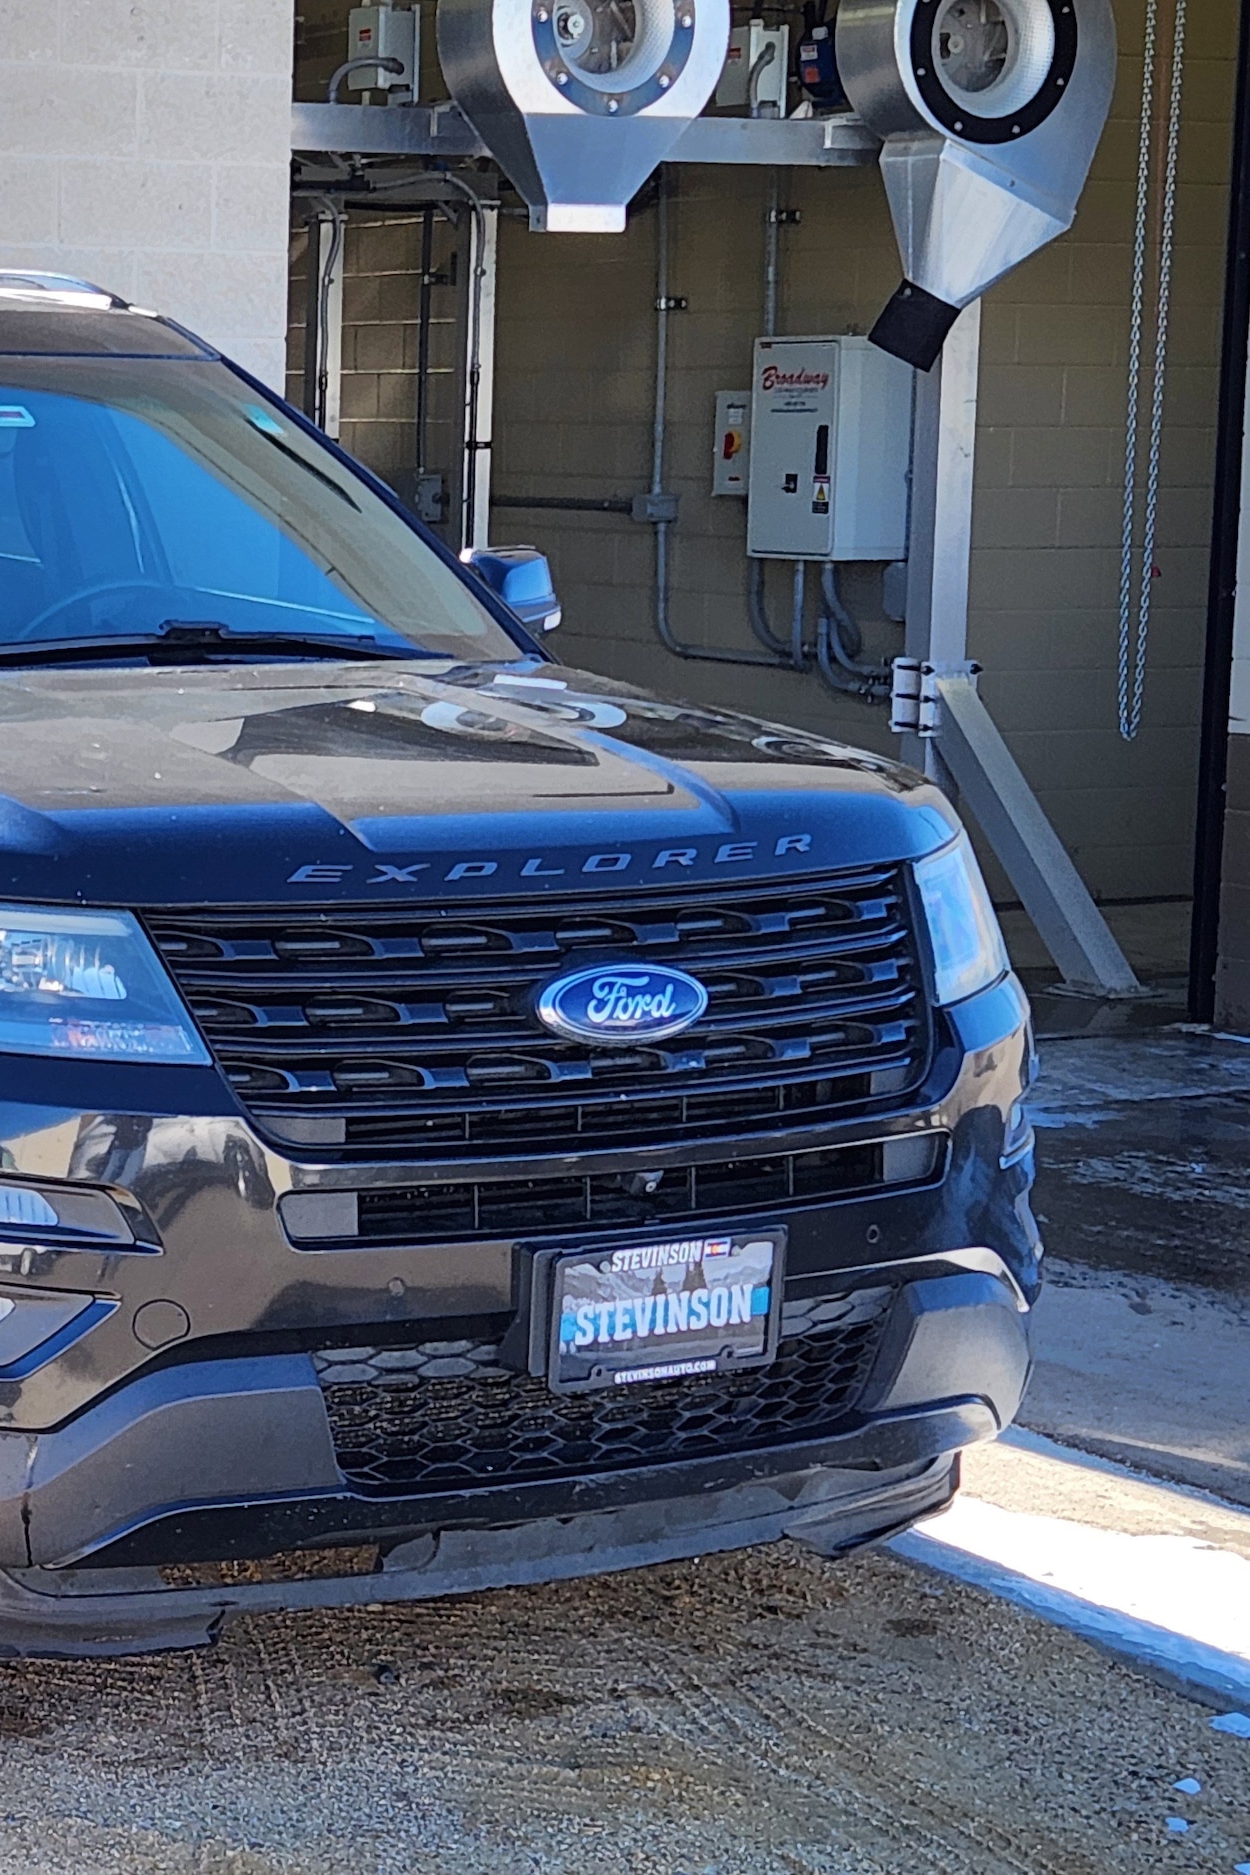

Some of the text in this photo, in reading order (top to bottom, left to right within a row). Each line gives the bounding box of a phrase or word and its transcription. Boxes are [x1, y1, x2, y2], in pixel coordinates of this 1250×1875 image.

[761, 365, 830, 391] Broadway
[286, 832, 814, 884] EXPLORER
[587, 975, 677, 1023] Ford
[611, 1240, 704, 1273] STEVINSON
[575, 1284, 754, 1347] STEVINSON
[614, 1359, 717, 1385] STEVINSONAUTO.COM
